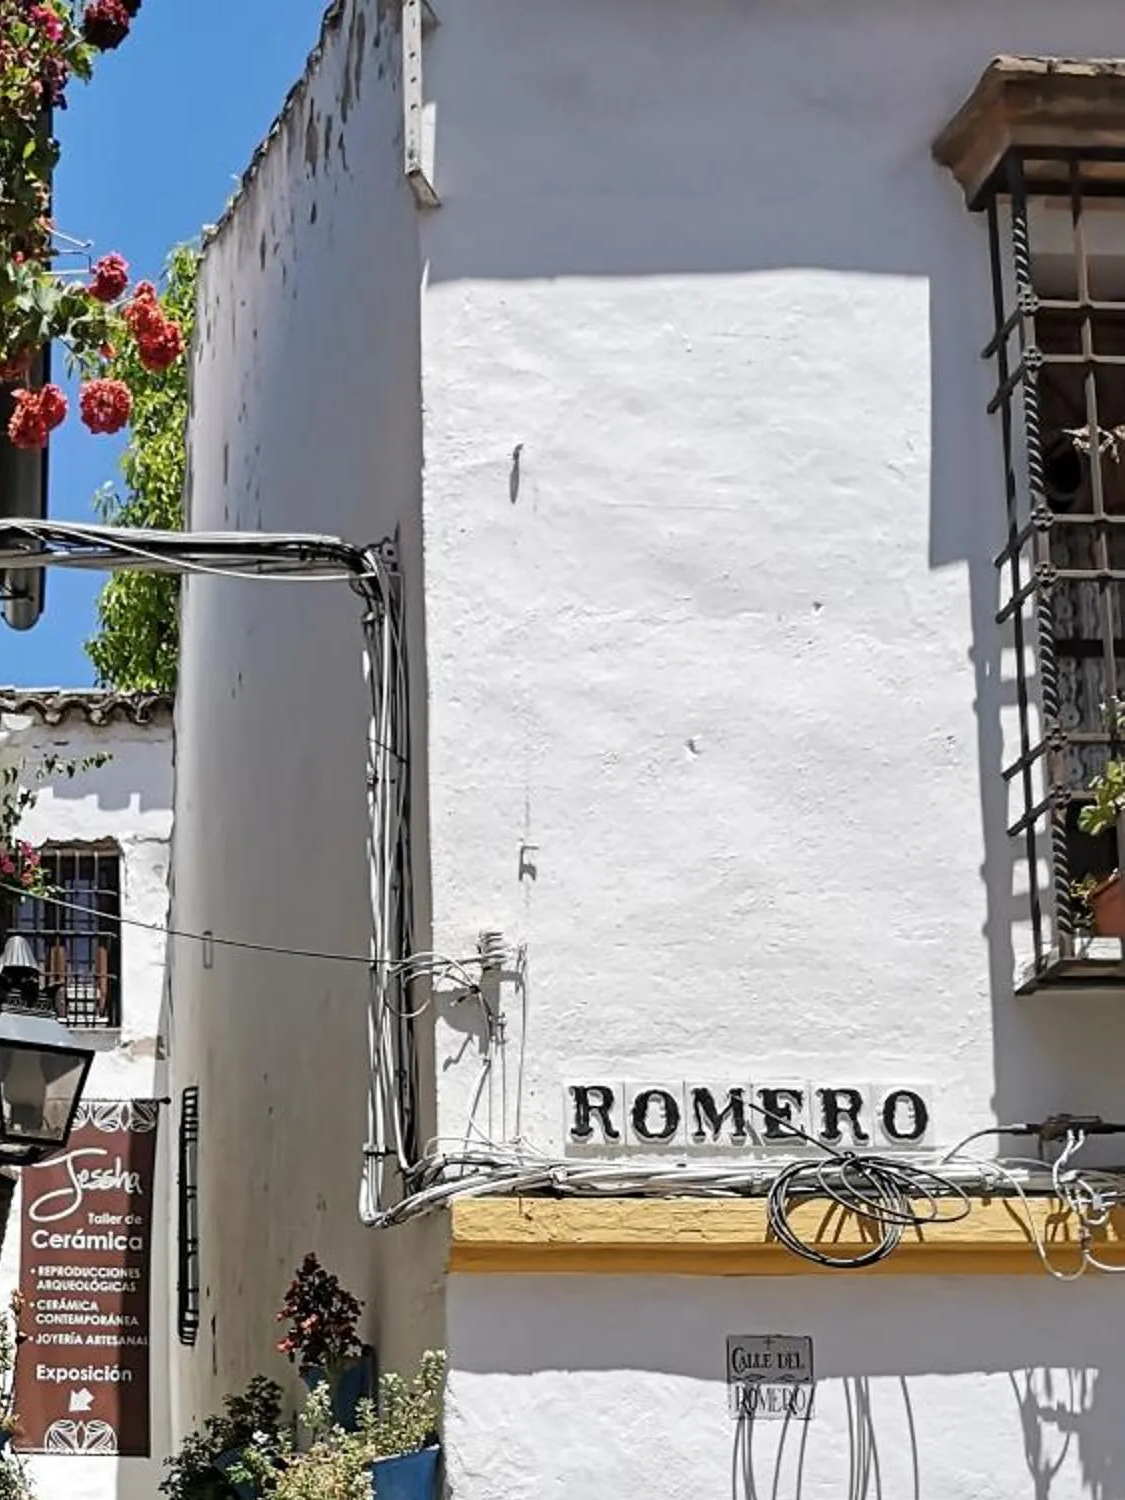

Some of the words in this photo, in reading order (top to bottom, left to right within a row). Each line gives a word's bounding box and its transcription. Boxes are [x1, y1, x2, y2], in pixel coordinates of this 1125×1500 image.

[569, 1084, 930, 1143] ROMERO
[87, 1212, 122, 1225] Taller
[124, 1212, 143, 1225] de
[31, 1228, 143, 1251] Cerámica
[37, 1265, 141, 1278] REPRODUCCIONES
[36, 1279, 136, 1292] ARQUEOLÓGICAS
[36, 1298, 99, 1311] CERÁMICA
[35, 1312, 139, 1326] CONTEMPORÁNEA
[36, 1331, 83, 1345] JOYERÍA
[731, 1346, 773, 1374] CALLE
[777, 1351, 806, 1369] DEL
[36, 1363, 132, 1383] Exposición
[735, 1385, 806, 1415] ROMERO
